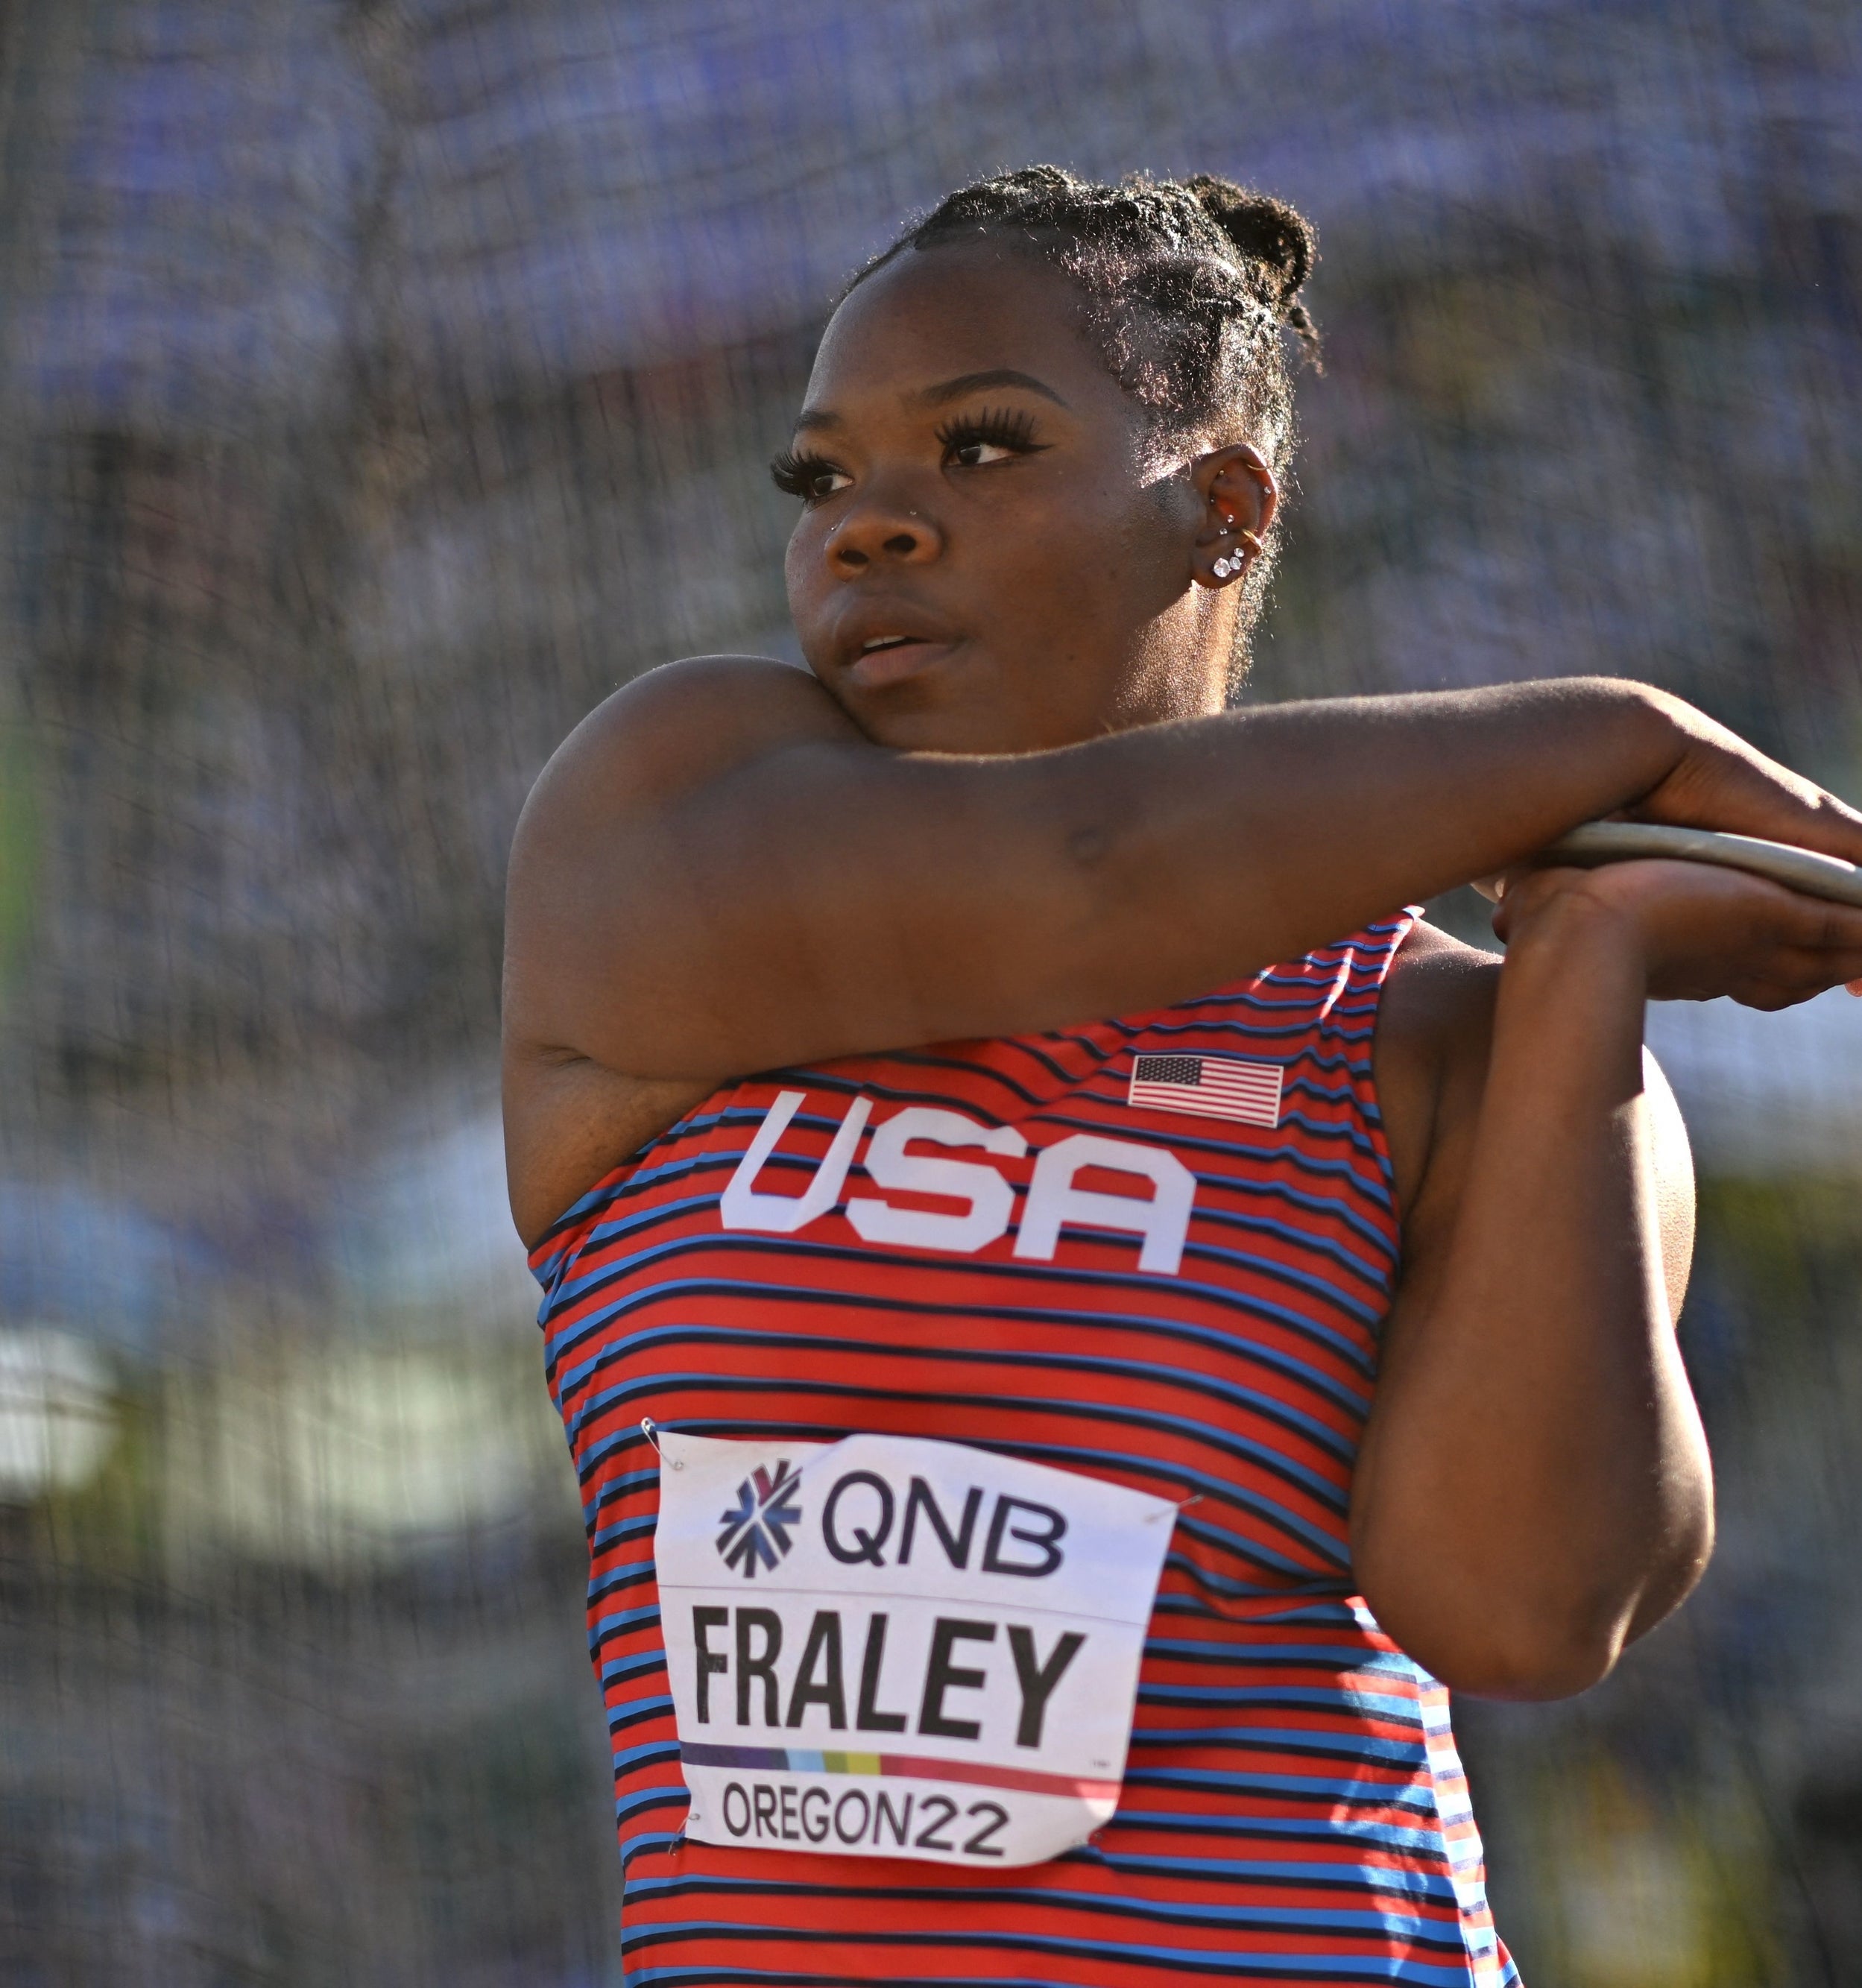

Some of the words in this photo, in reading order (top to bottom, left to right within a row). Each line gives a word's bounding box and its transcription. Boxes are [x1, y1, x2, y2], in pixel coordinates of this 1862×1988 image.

[720, 1091, 1197, 1275] USA
[821, 1470, 1068, 1577] QNB
[692, 1605, 1088, 1749] FRALEY
[722, 1782, 1009, 1857] OREGON22
